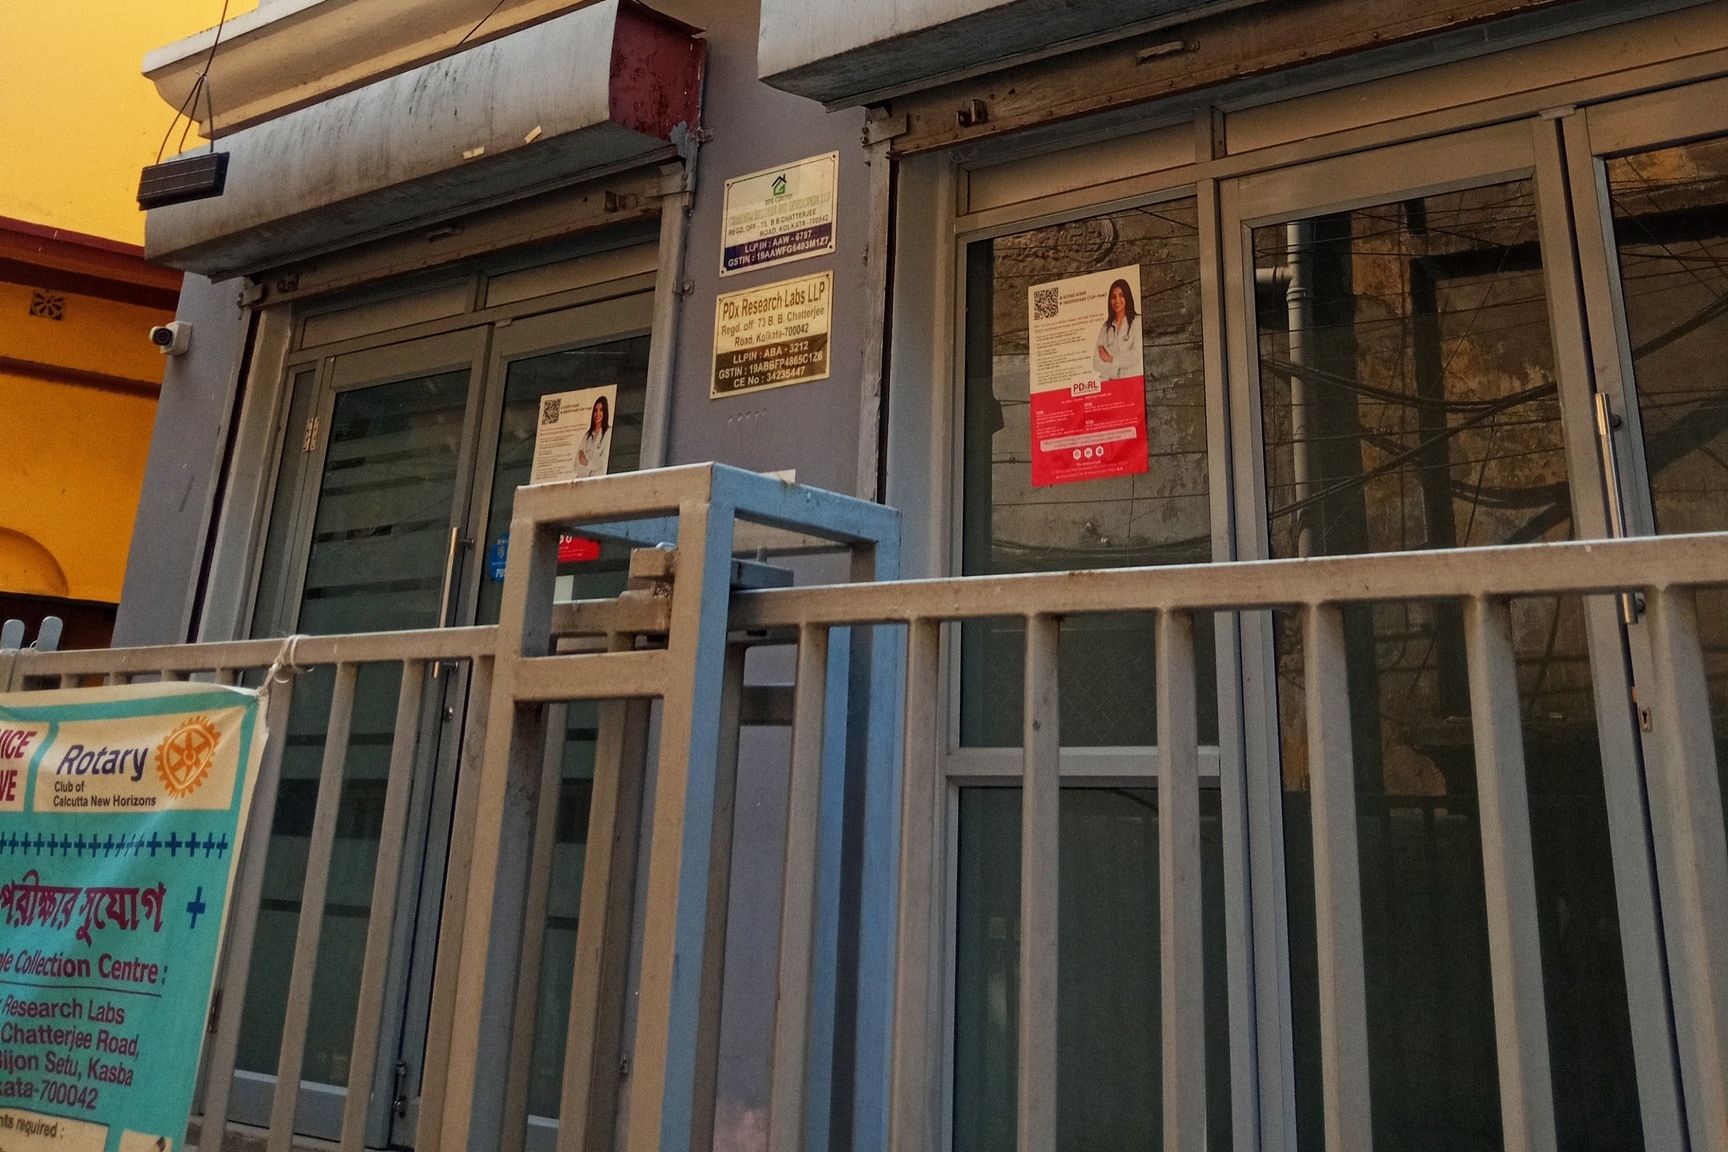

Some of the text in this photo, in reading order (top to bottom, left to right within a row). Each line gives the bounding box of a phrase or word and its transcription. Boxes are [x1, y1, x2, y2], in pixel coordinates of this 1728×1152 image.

[781, 208, 817, 224] CHATTERJEE
[772, 235, 790, 248] AAW
[728, 255, 750, 267] GSTIN
[722, 281, 825, 321] PDx Research Labs LLP
[787, 306, 825, 322] Chatterjee
[763, 347, 782, 358] ABA
[789, 341, 809, 353] 3212
[718, 367, 743, 379] GSTIN
[734, 377, 745, 388] CE
[748, 374, 759, 385] No
[767, 366, 806, 382] 34235447
[56, 744, 149, 782] Rotary
[54, 781, 85, 793] Club of
[53, 796, 156, 807] Calcutta New Horizons
[14, 949, 90, 978] Collection
[1, 994, 125, 1025] Research Labs
[1, 1021, 139, 1060] Chatterjee Road,
[45, 1051, 82, 1081] Setu,
[87, 1057, 134, 1087] Kasba
[16, 1119, 58, 1139] required
